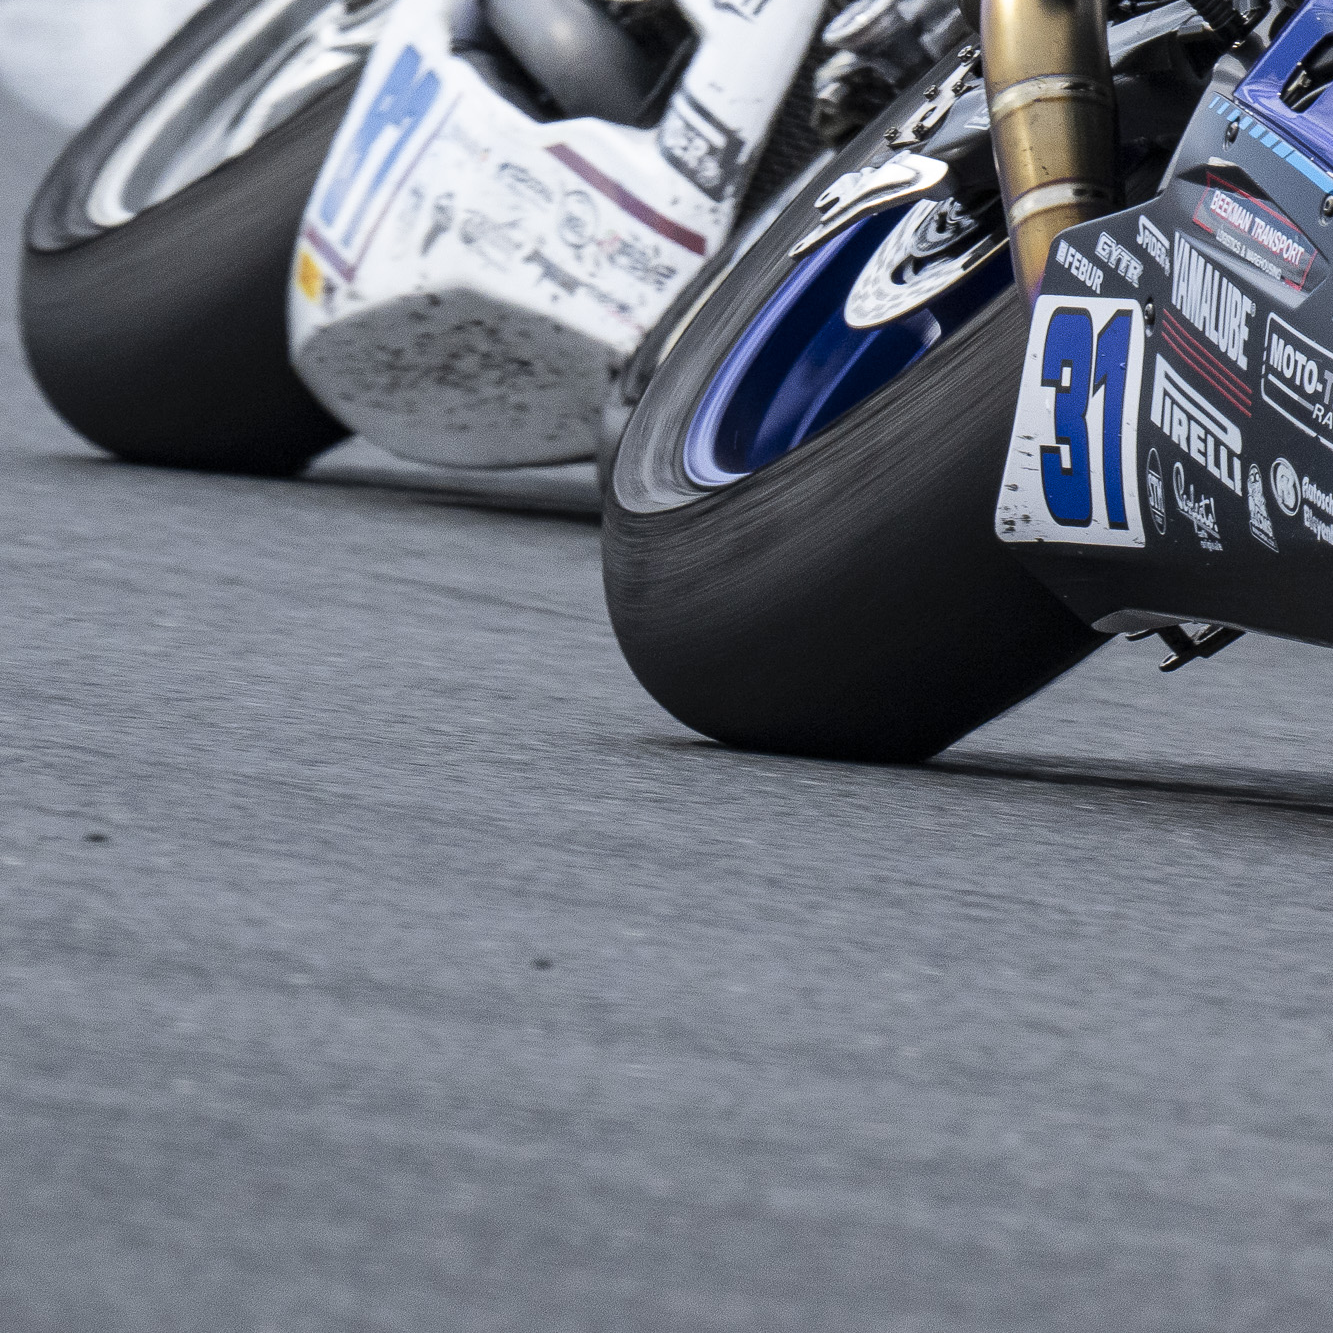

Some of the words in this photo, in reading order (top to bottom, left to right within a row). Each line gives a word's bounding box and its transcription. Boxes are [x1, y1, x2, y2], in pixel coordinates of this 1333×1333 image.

[1064, 245, 1104, 294] FEBUR
[1210, 190, 1253, 233] BEEKMAN
[1251, 216, 1305, 266] TRANSPORT
[1171, 230, 1252, 371] YAMALUBE
[1040, 307, 1134, 531] 31
[1150, 352, 1243, 497] PIRELLI
